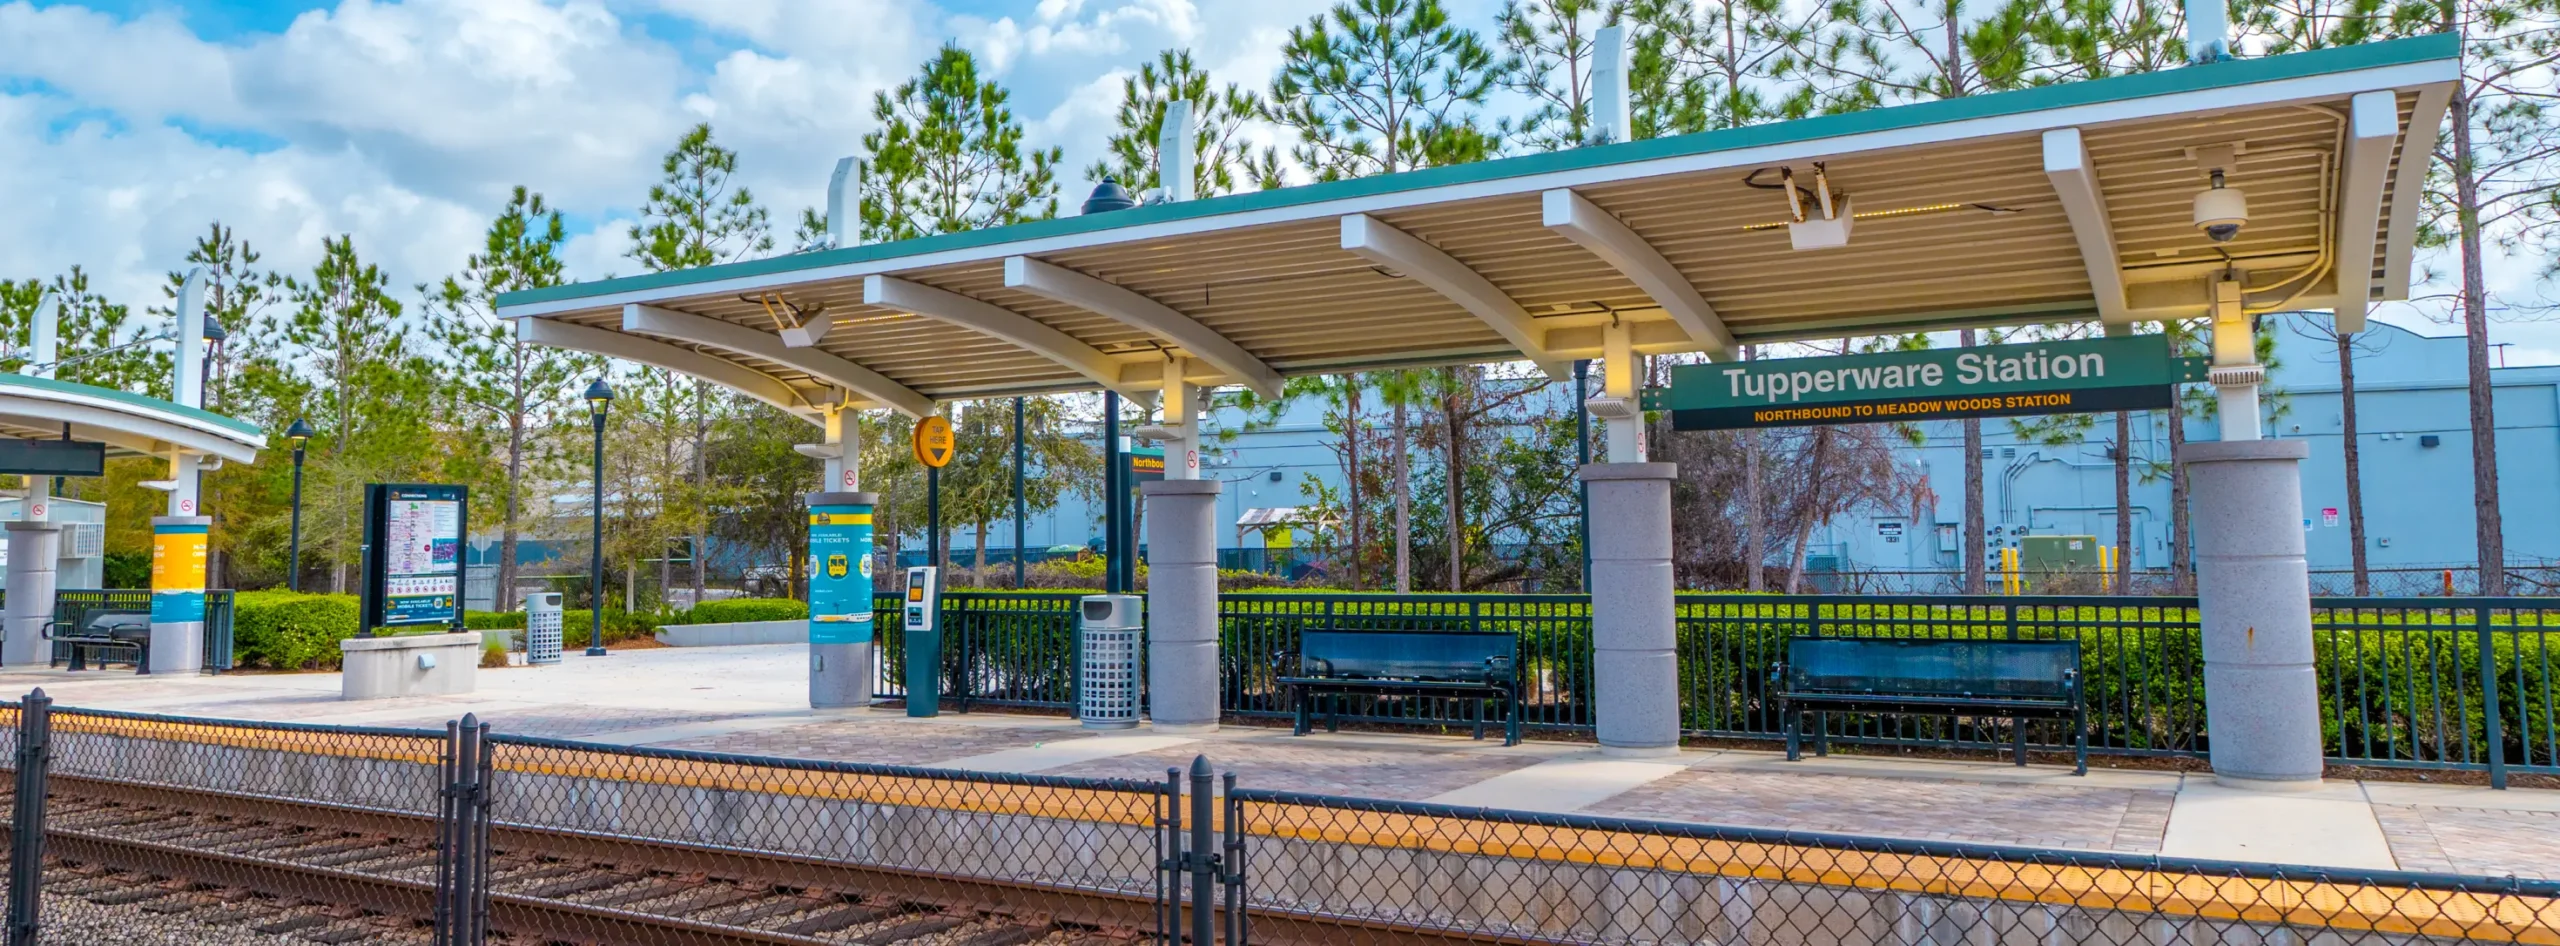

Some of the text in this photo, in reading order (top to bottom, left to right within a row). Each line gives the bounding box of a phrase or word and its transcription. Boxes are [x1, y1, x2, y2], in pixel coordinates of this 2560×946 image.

[1722, 348, 2105, 403] Tupperware Station
[1754, 393, 2072, 423] NORTHBOUND TO MEADOW WOODS STATION
[931, 425, 945, 434] TAP
[929, 435, 948, 445] HERE
[1132, 456, 1164, 469] Northbou
